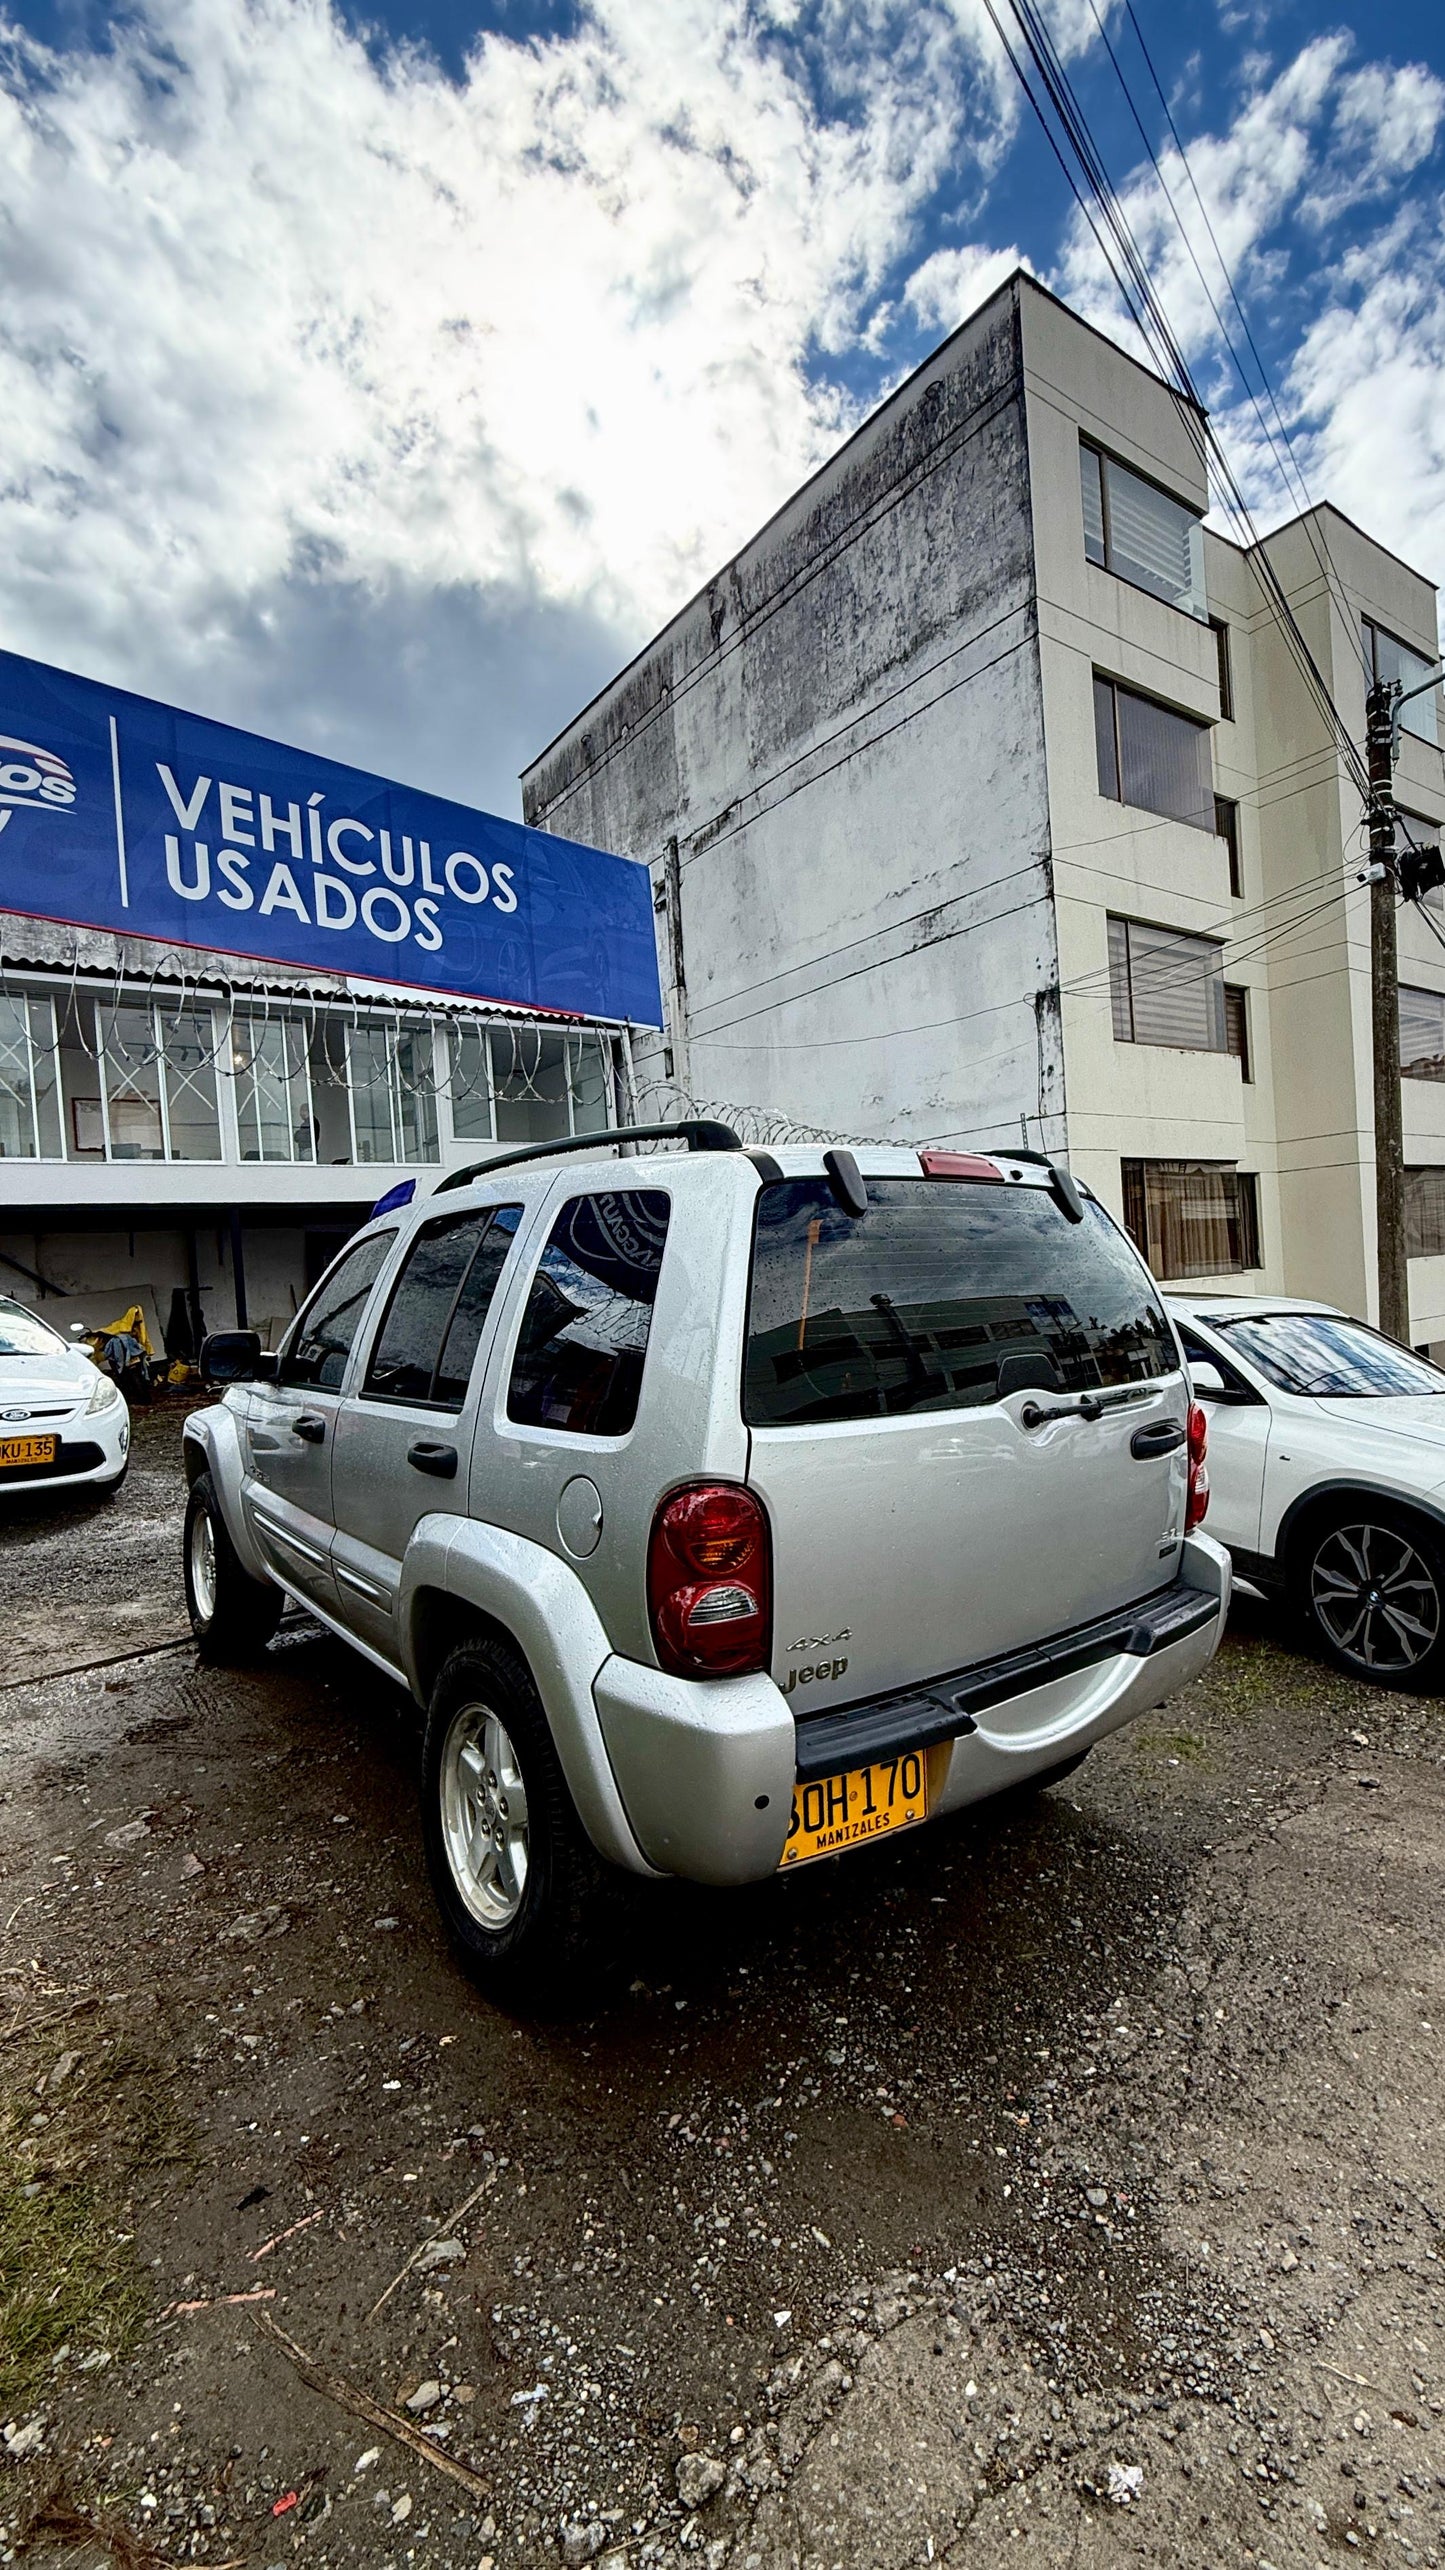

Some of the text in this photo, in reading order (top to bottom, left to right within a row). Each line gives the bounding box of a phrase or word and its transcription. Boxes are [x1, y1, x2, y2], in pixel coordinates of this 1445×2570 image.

[155, 762, 518, 913] VEHÍCULOS
[164, 834, 443, 952] USADOS
[778, 1656, 848, 1695] Jeep
[816, 1812, 890, 1849] MANIZALES
